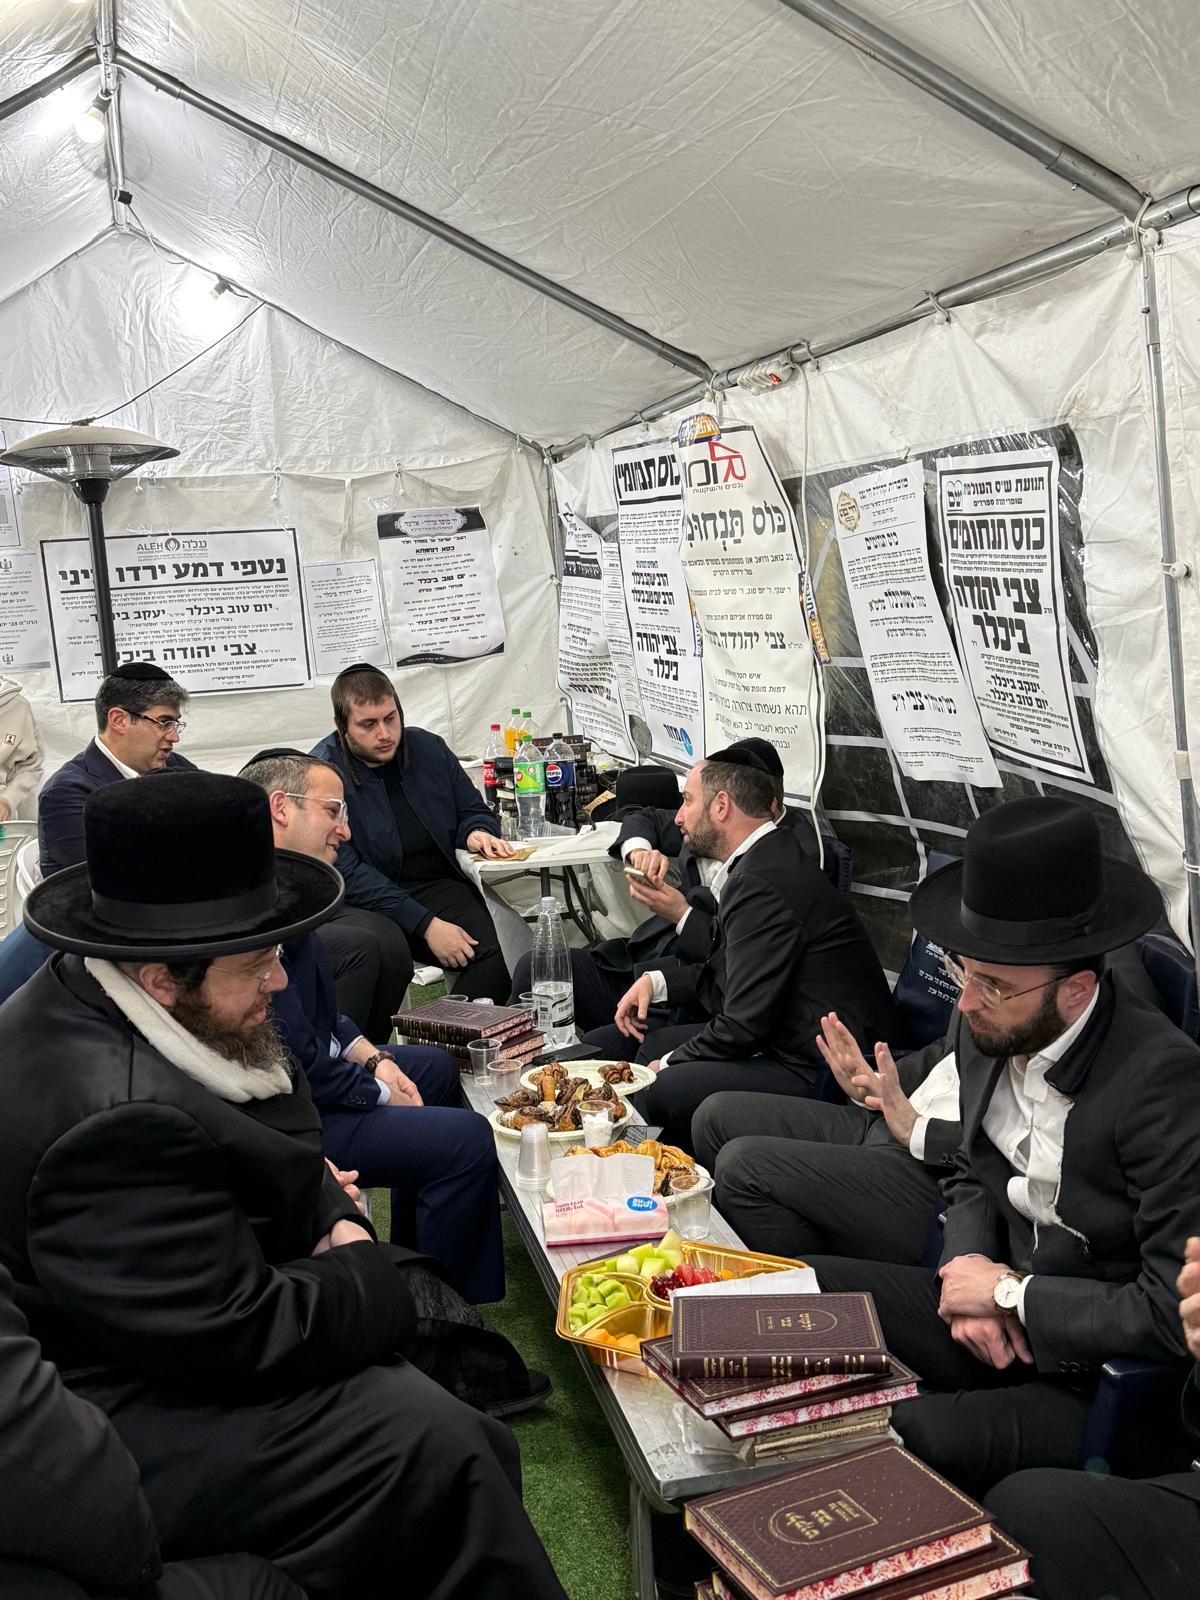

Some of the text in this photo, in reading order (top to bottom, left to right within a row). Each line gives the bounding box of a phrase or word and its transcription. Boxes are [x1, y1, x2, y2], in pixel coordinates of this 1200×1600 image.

[693, 482, 744, 494] נכסים והשקעות
[1015, 477, 1045, 492] תנועת
[974, 499, 995, 507] ספרדים
[948, 517, 1045, 550] כוס תנחומים
[137, 541, 164, 552] ALEH
[182, 540, 207, 549] עלה
[59, 558, 286, 585] נטפי דמע ירדו יני
[709, 587, 721, 596] לבית
[953, 574, 1001, 611] יהודה
[1003, 577, 1043, 615] צבי
[134, 609, 166, 621] יעקב
[186, 605, 224, 616] ביכלר
[228, 604, 250, 613] טוב
[253, 603, 273, 613] יום
[90, 610, 130, 622] ביר
[720, 631, 760, 650] יהודה
[764, 631, 786, 649] צבי
[972, 611, 1031, 655] ביכלר
[224, 643, 257, 656] צבי
[636, 631, 661, 653] יהודה
[661, 634, 679, 656] צבי
[163, 645, 216, 661] יהודה
[653, 655, 679, 680] ביכלר
[751, 685, 767, 693] מופת
[991, 673, 1041, 695] יעקב ביכלר
[990, 687, 1049, 710] יום טוב ביכלר
[732, 699, 807, 715] תהא נשמתו צרורה
[744, 720, 753, 730] לב
[754, 722, 773, 733] לשבורי
[812, 1508, 834, 1527] צבי
